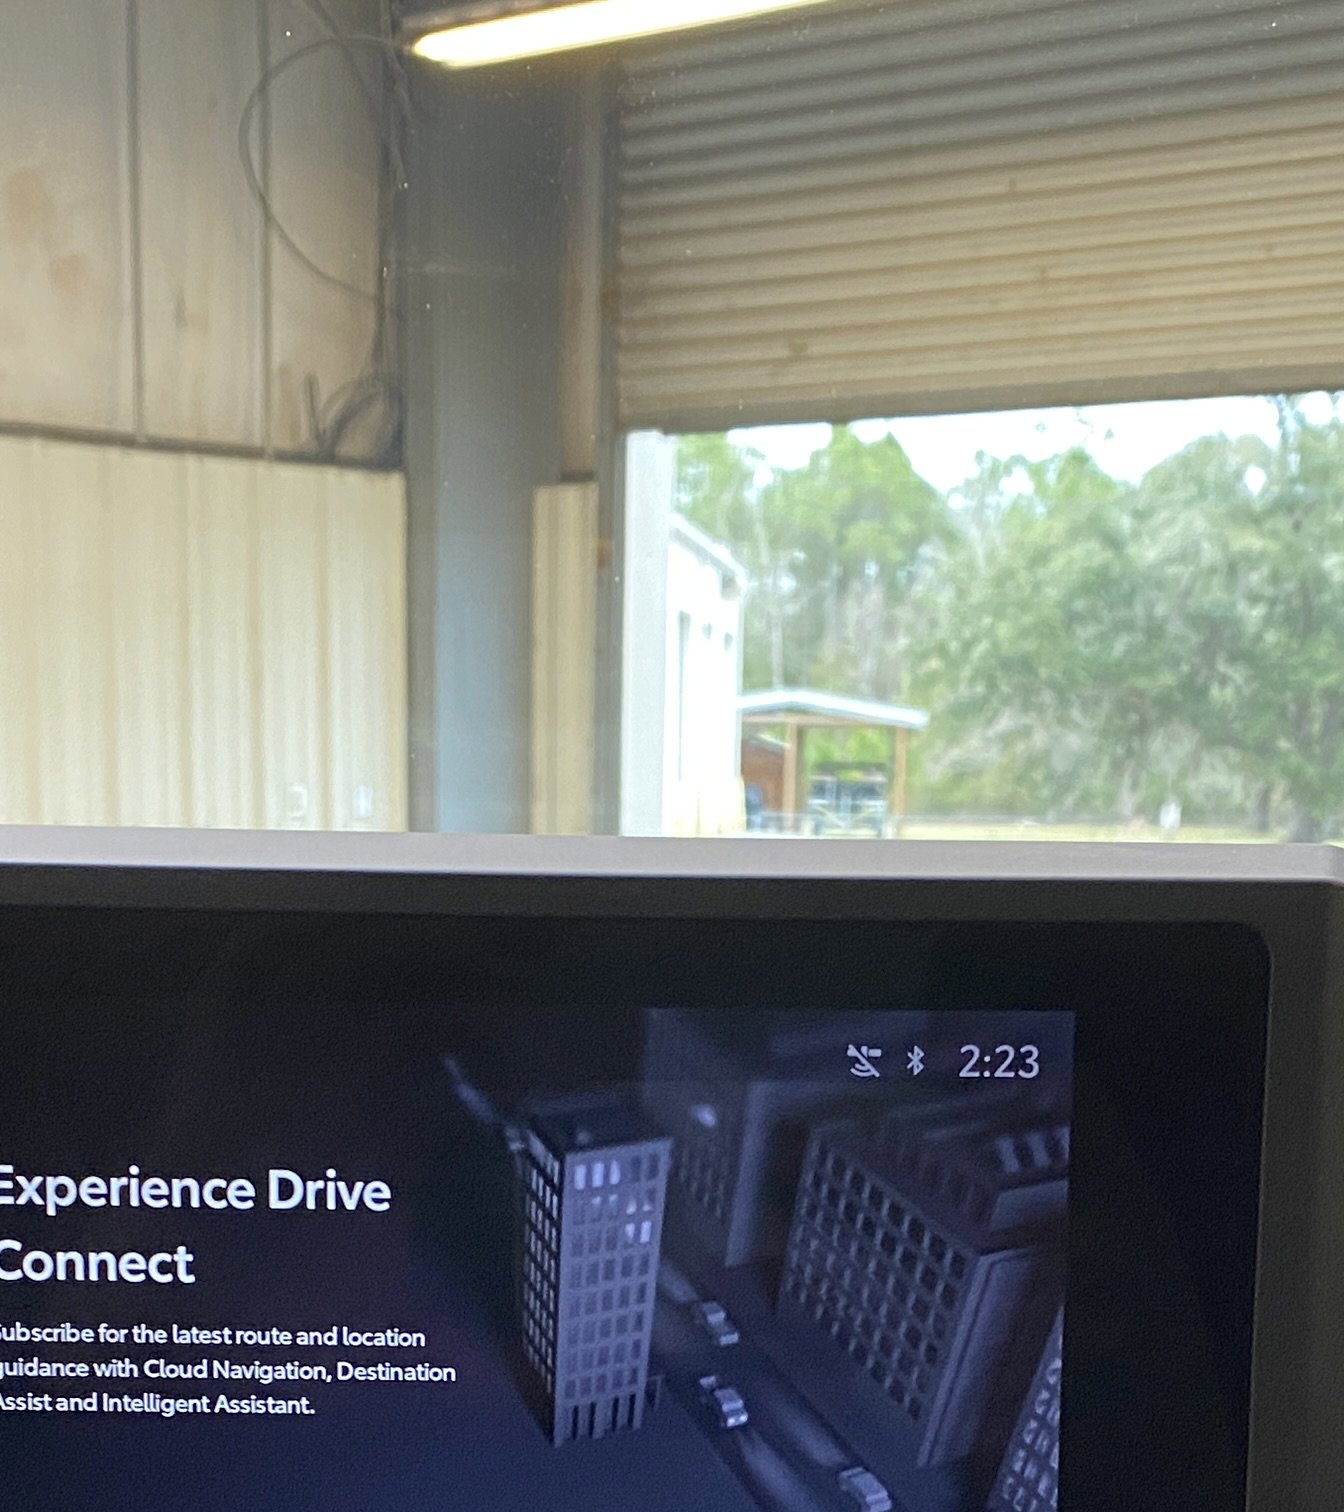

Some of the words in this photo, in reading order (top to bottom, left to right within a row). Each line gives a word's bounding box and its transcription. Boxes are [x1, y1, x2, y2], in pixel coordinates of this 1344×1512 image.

[958, 1045, 1040, 1080] 2:23
[267, 1168, 392, 1212] Drive
[98, 1323, 128, 1344] for
[132, 1323, 168, 1344] the
[172, 1324, 233, 1346] latest
[235, 1327, 293, 1346] route
[296, 1326, 338, 1347] and
[342, 1327, 426, 1348] location
[93, 1358, 139, 1379] with
[143, 1359, 208, 1380] Cloud
[213, 1360, 333, 1384] Navigation,
[337, 1362, 457, 1383] Destination
[55, 1392, 98, 1412] and
[103, 1393, 210, 1417] Intelligent
[214, 1395, 316, 1415] Assistant.
